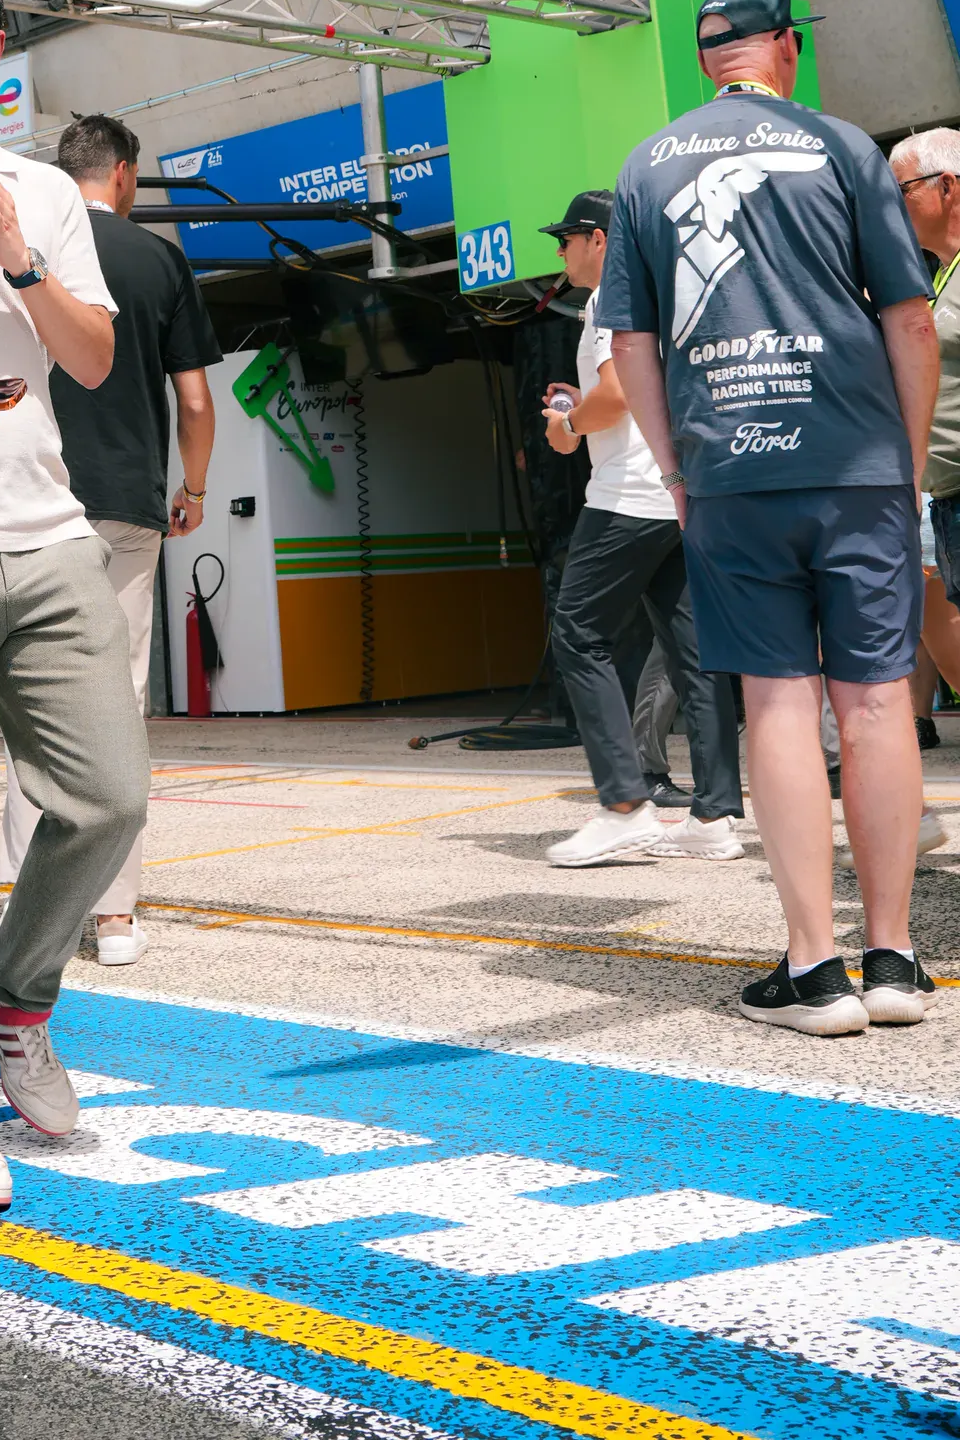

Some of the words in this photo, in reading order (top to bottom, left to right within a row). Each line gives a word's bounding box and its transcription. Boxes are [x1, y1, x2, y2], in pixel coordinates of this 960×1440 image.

[650, 133, 740, 167] Deluxe
[745, 122, 825, 150] Series
[279, 165, 338, 193] INTER
[340, 141, 431, 178] EUPOL
[293, 160, 433, 204] COMPETION
[461, 226, 512, 286] 343
[300, 382, 330, 393] INTER
[706, 361, 813, 383] PERFORMANCE
[712, 381, 765, 401] RACING
[768, 379, 813, 393] TIRES
[730, 421, 802, 455] Ford
